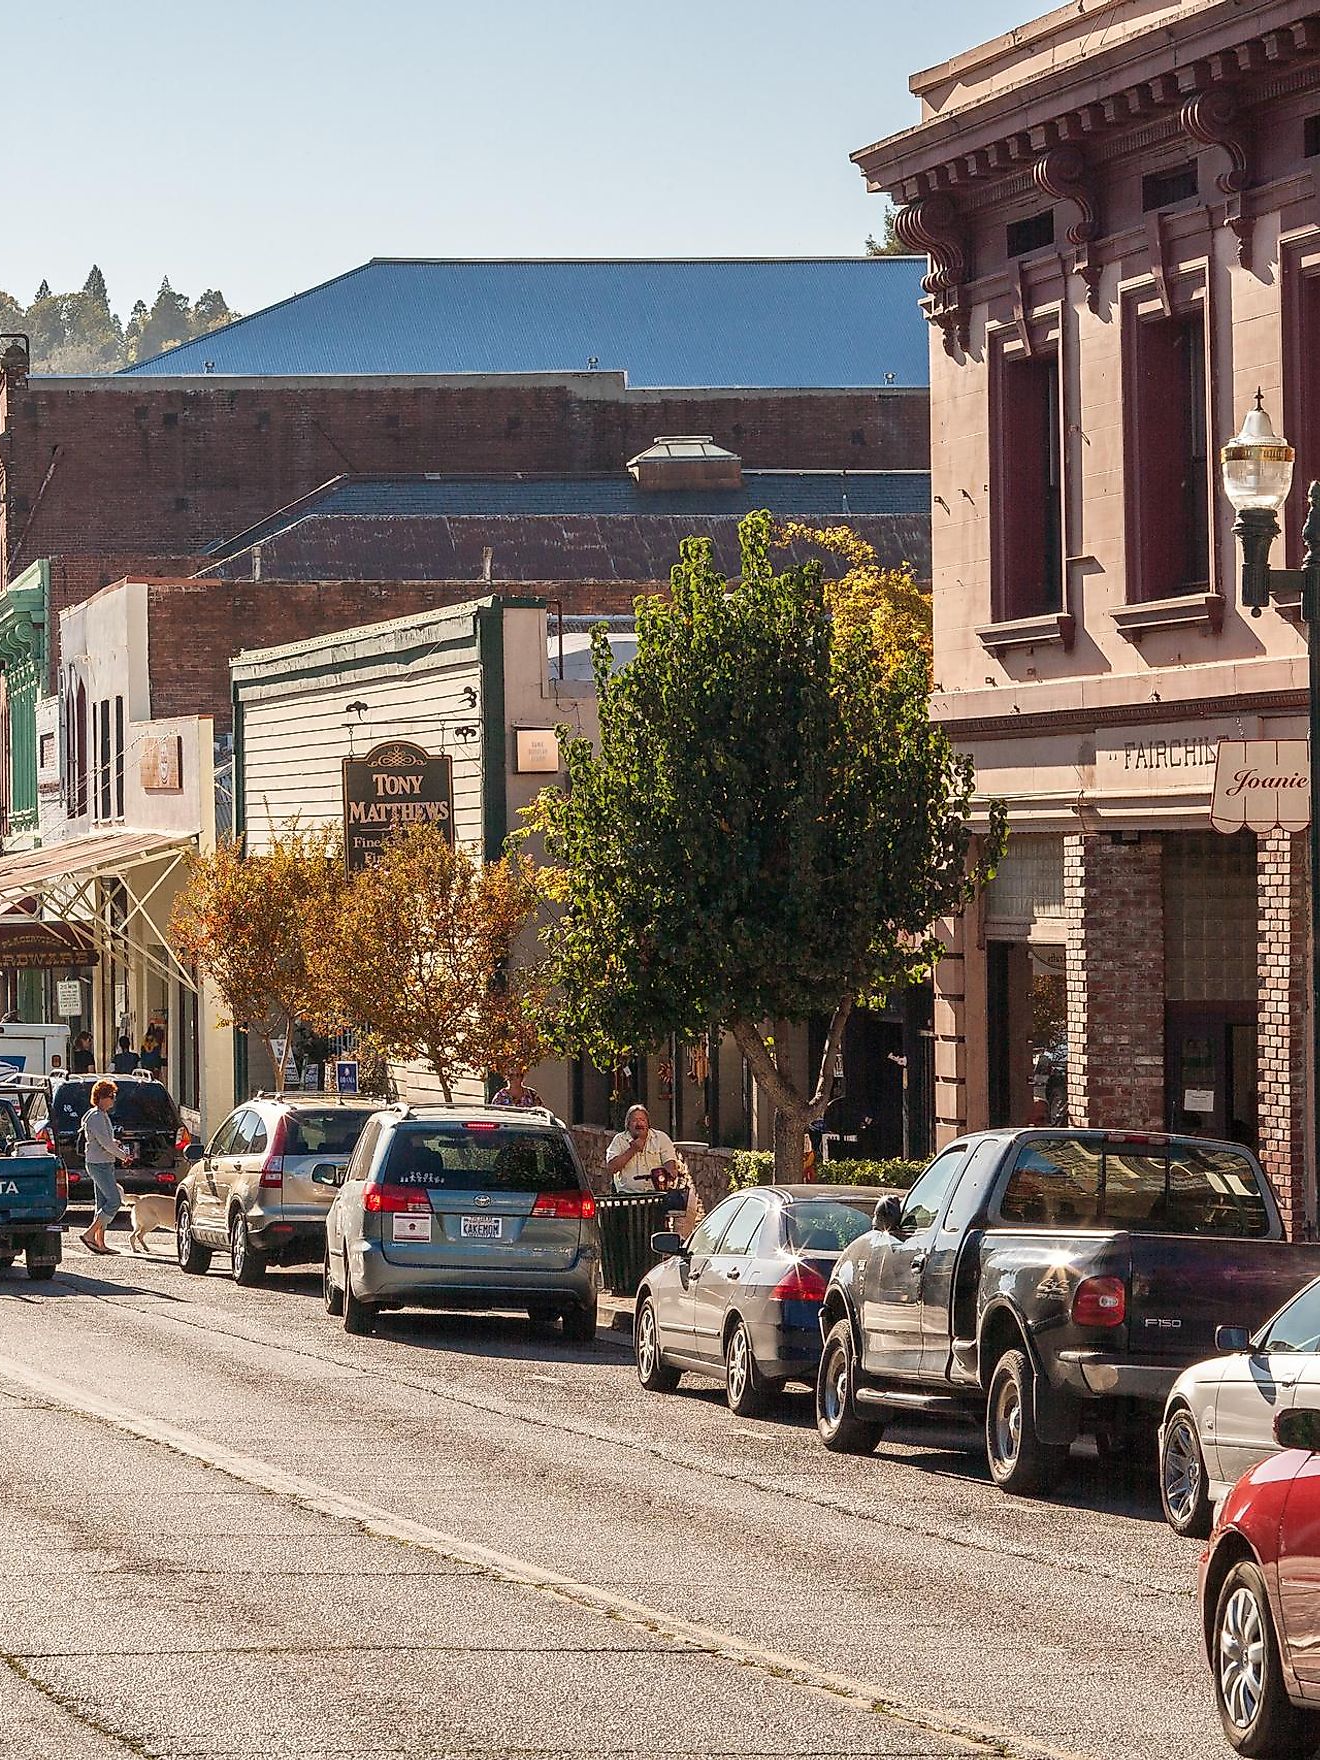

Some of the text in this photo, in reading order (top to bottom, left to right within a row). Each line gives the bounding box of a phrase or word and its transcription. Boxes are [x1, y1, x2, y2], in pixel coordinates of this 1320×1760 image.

[1124, 734, 1230, 770] FAIRCHIL
[372, 773, 424, 797] TONY
[348, 801, 449, 824] MATTHEWS
[352, 837, 380, 849] Fine
[1144, 1318, 1182, 1328] F150
